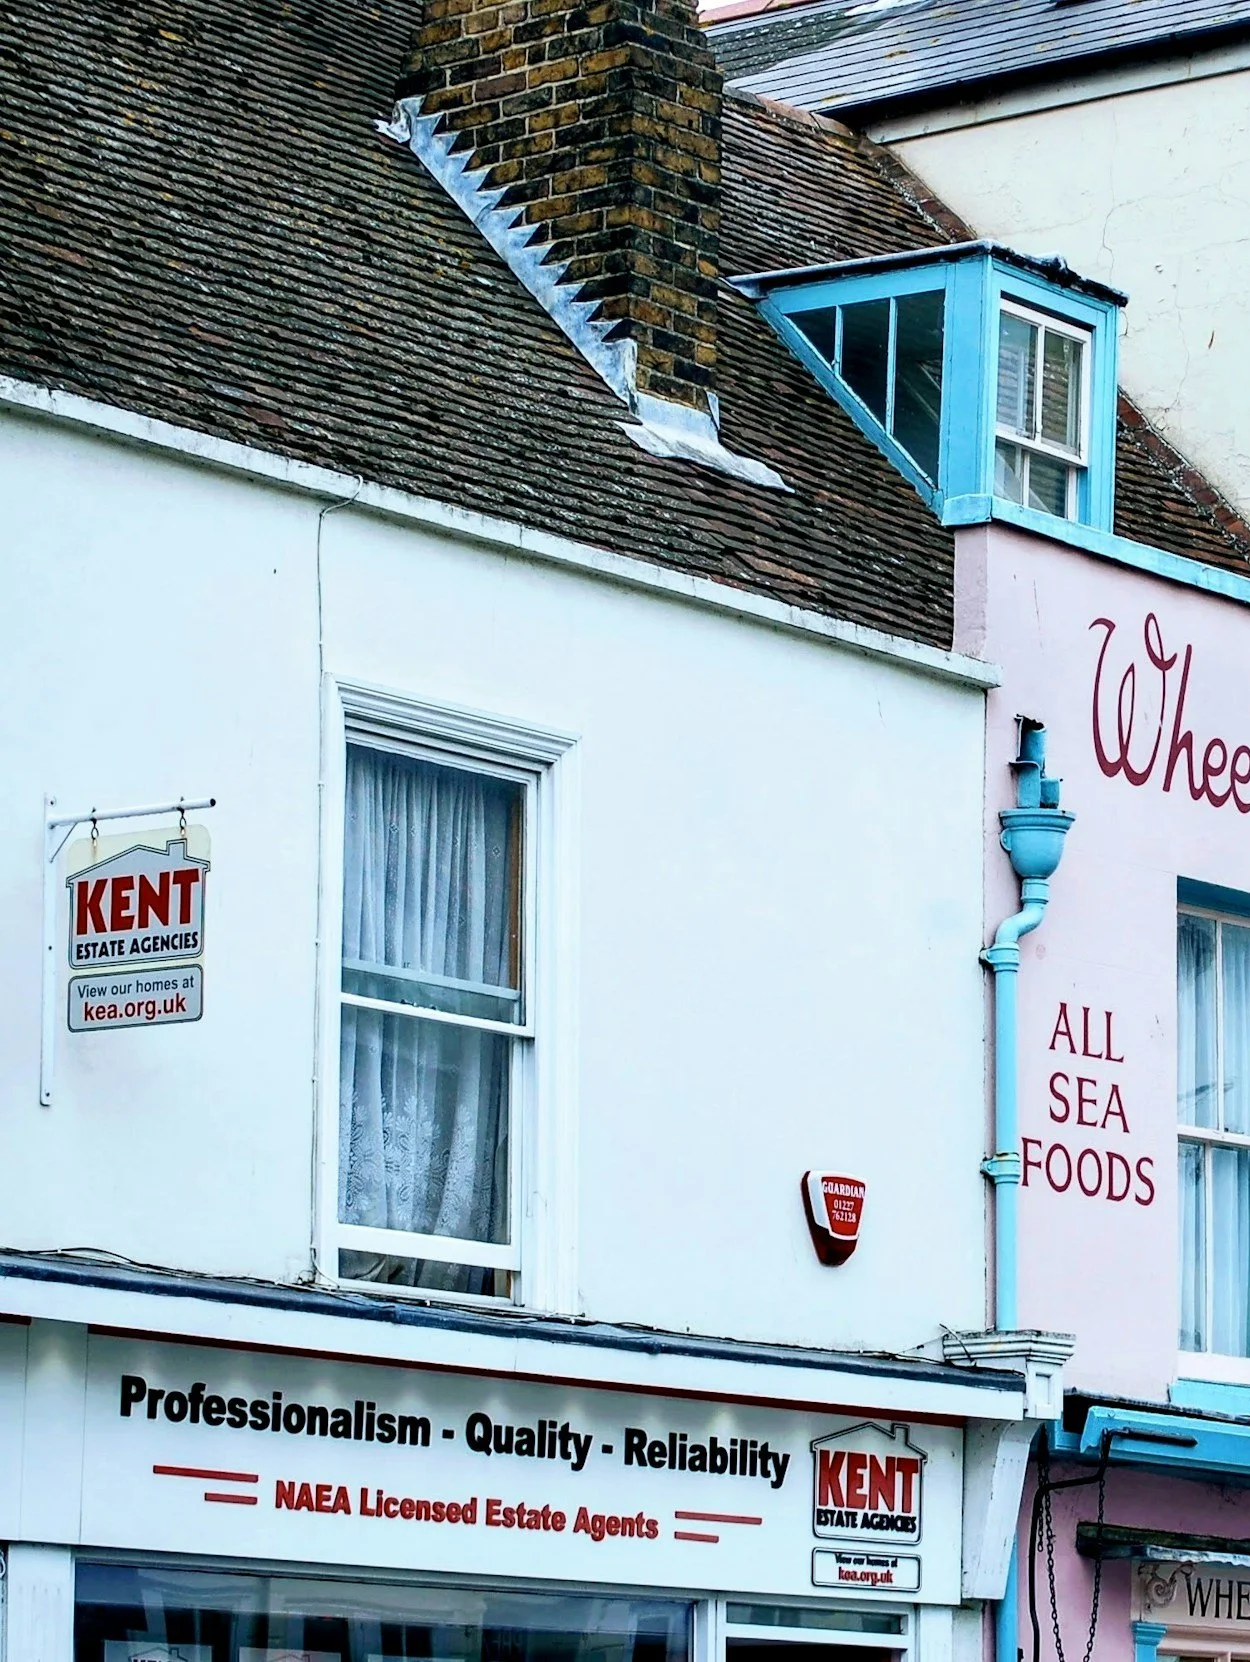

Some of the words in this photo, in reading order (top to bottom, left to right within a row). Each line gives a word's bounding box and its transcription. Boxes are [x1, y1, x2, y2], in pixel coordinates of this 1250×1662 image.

[76, 868, 200, 936] KENT
[76, 938, 125, 961] ESTATE
[130, 931, 199, 956] AGENCIES
[77, 983, 108, 998] View
[111, 984, 132, 996] our
[136, 978, 178, 993] homes
[182, 975, 195, 989] at
[84, 993, 187, 1022] kea.org.uk
[1049, 1002, 1124, 1063] ALL
[1049, 1072, 1130, 1133] SEA
[822, 1181, 865, 1198] GUARDIAN
[1021, 1137, 1155, 1206] FOODS
[119, 1375, 431, 1447] Professionalism
[465, 1412, 593, 1471] Quality
[624, 1427, 790, 1489] Reliability
[275, 1480, 351, 1516] NAEA
[360, 1488, 477, 1525] Licensed
[486, 1498, 567, 1532] Estate
[573, 1506, 659, 1542] Agents
[818, 1449, 919, 1514] KENT
[816, 1508, 858, 1528] ESTATE
[861, 1512, 917, 1533] AGENCIES
[838, 1567, 893, 1586] kea.org.uk
